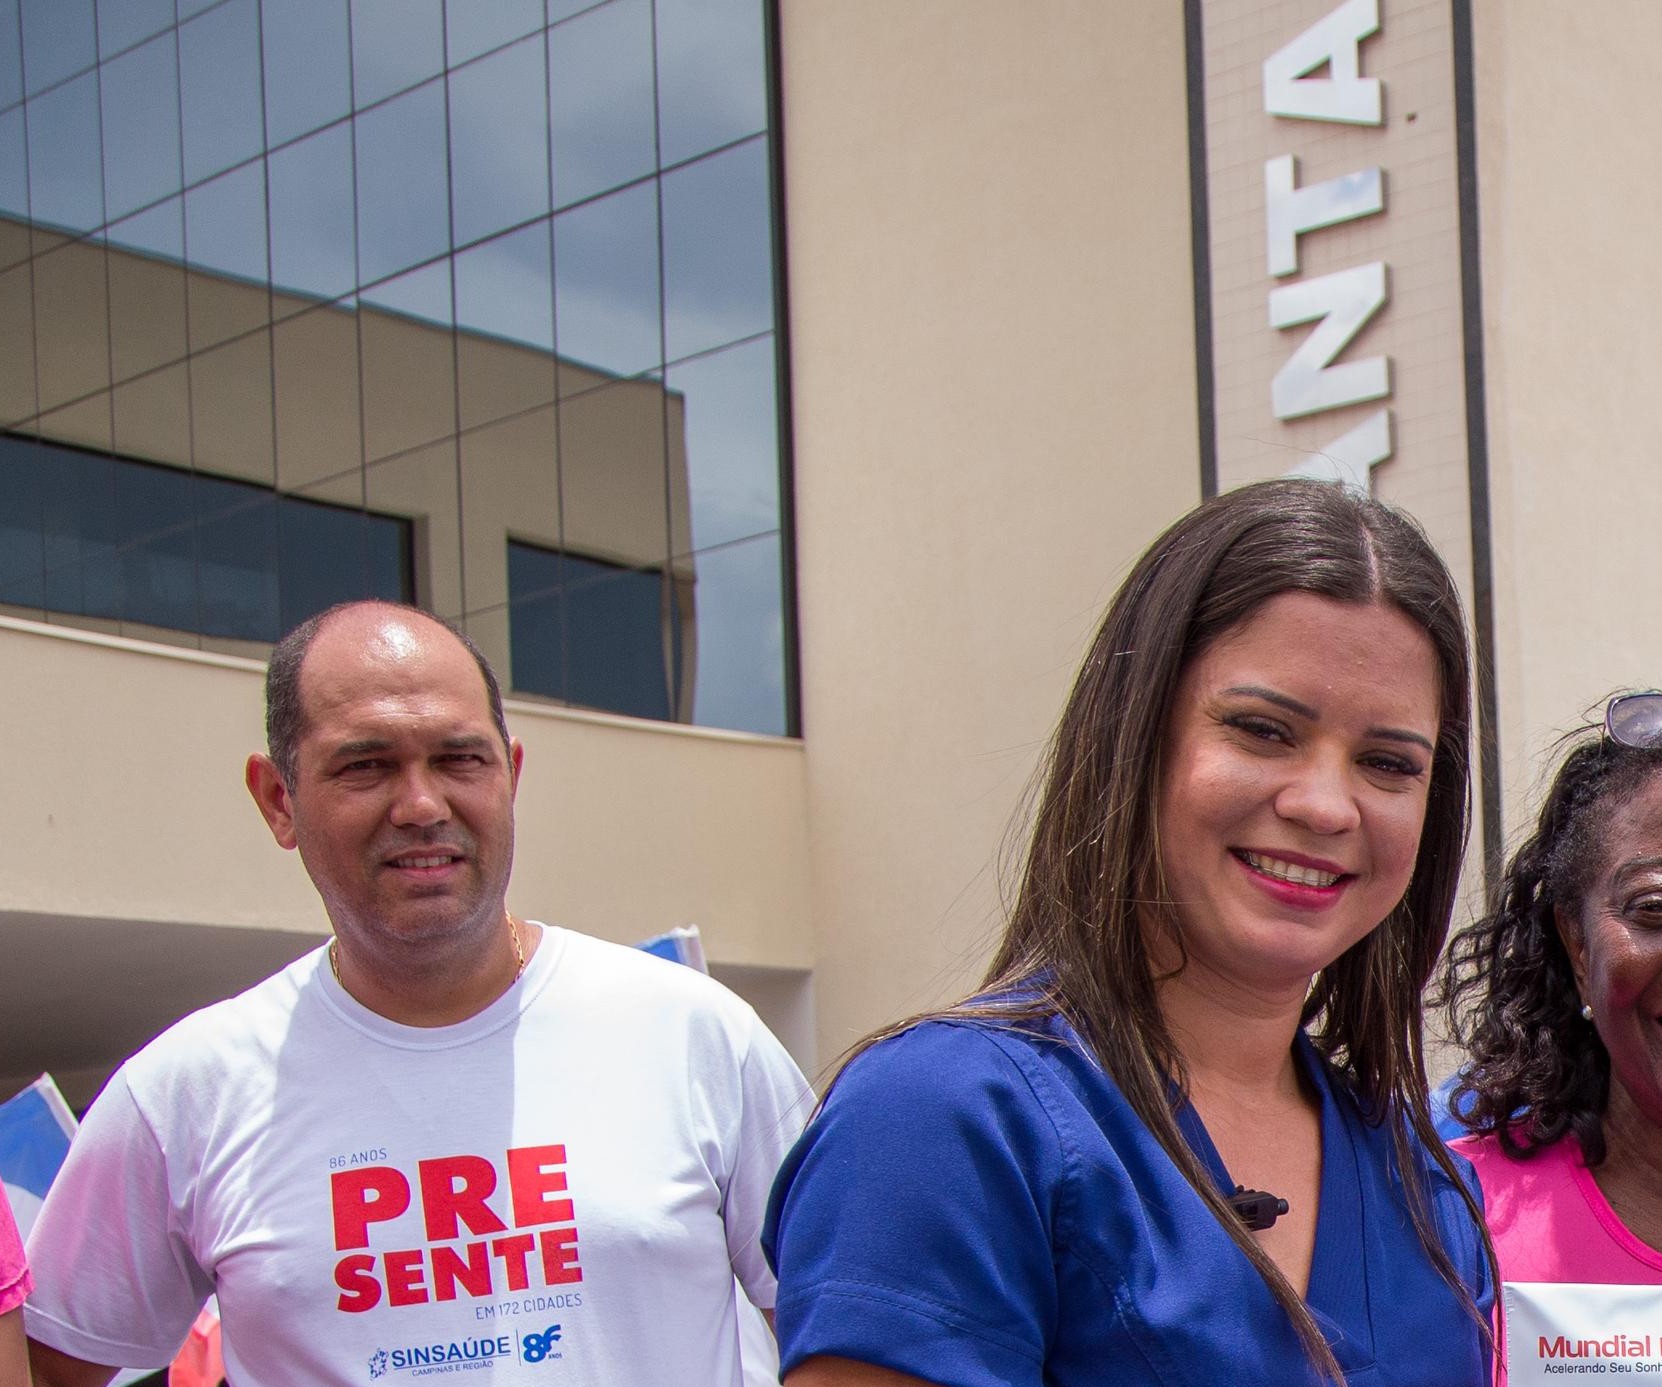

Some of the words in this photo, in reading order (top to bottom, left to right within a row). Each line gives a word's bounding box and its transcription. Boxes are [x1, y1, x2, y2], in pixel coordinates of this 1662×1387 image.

[329, 1156, 346, 1169] 86
[350, 1148, 387, 1166] ANOS
[330, 1144, 575, 1251] PRE
[334, 1227, 583, 1313] SENTE
[476, 1304, 495, 1320] EM
[499, 1301, 520, 1317] 172
[523, 1293, 583, 1314] CIDADES
[391, 1335, 511, 1368] SINSAÚDE
[1538, 1335, 1651, 1358] Mundial
[412, 1364, 454, 1377] CAMPINAS
[455, 1364, 461, 1372] E
[462, 1360, 494, 1372] REGIÃO
[1544, 1362, 1606, 1374] Acelerando
[1609, 1362, 1632, 1373] Seu
